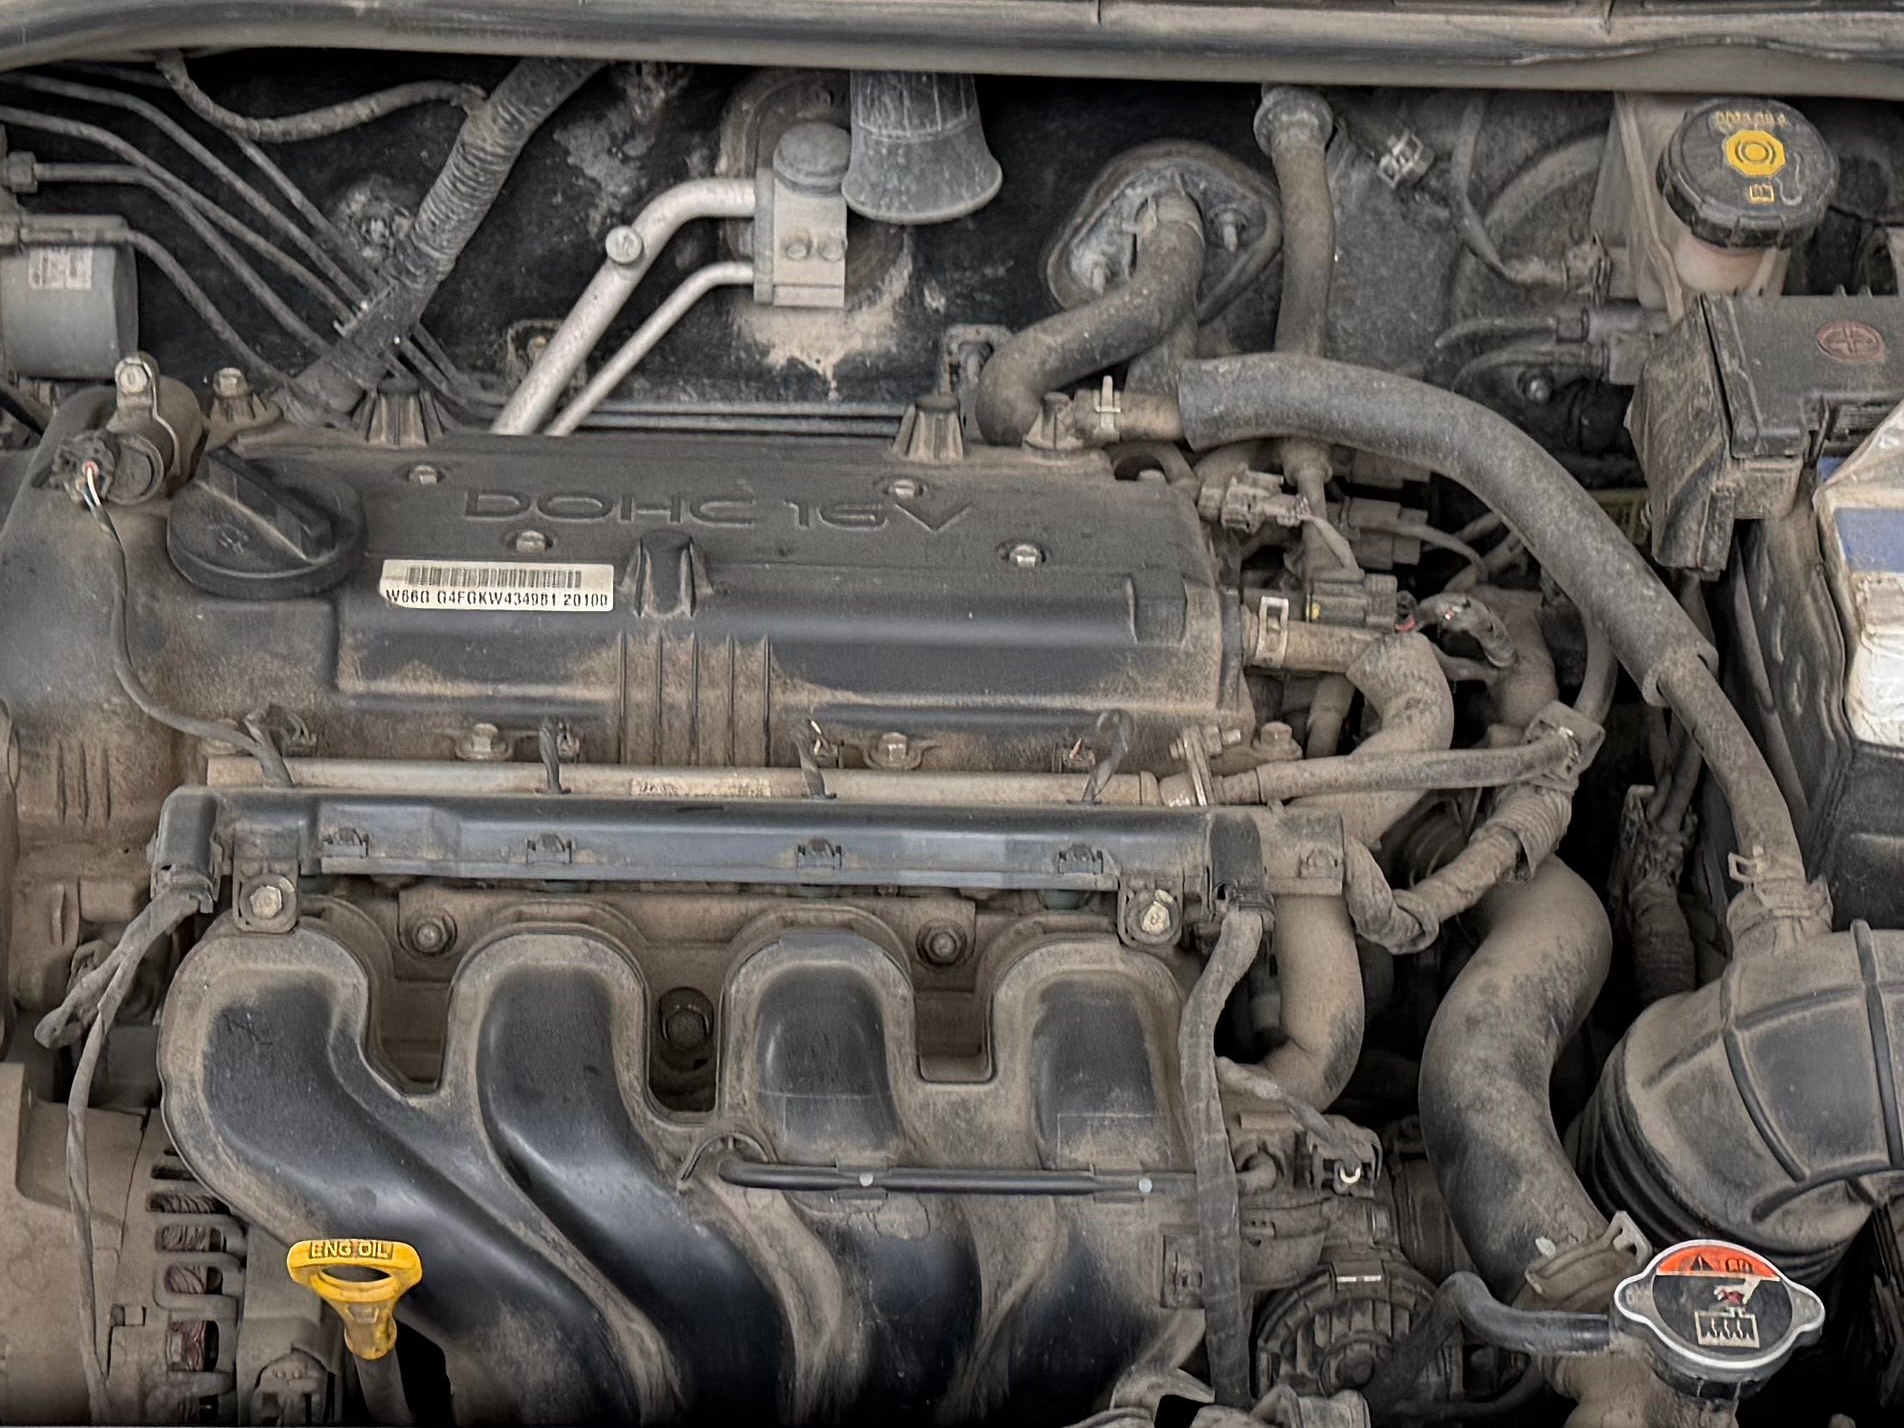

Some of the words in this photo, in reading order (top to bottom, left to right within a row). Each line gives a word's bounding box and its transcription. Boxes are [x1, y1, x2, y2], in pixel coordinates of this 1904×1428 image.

[463, 488, 757, 529] DOHC
[783, 499, 975, 534] 16V
[563, 592, 609, 608] 20100
[310, 1240, 352, 1259] ENG
[357, 1240, 389, 1259] OIL
